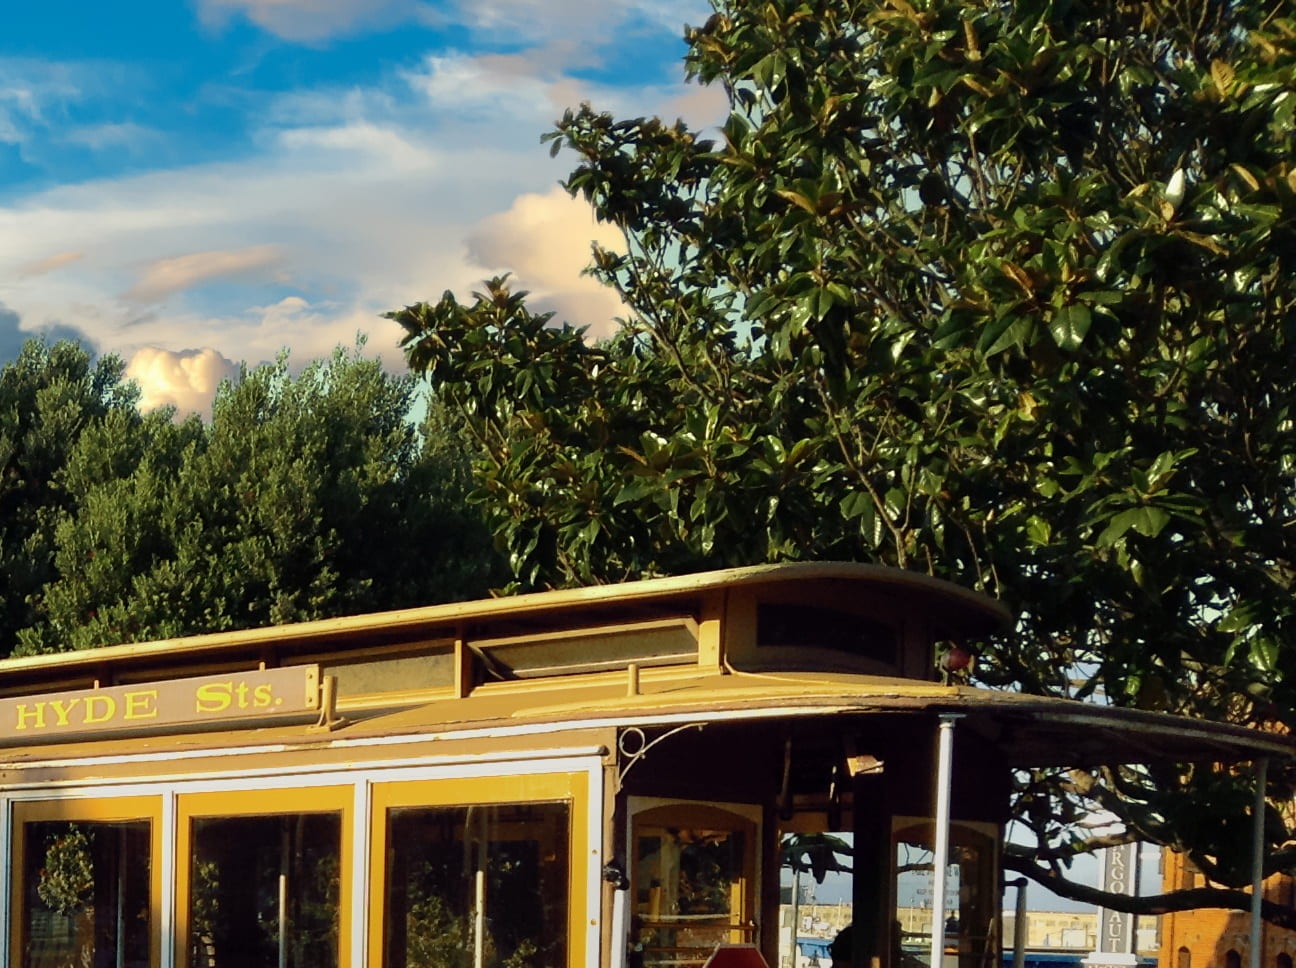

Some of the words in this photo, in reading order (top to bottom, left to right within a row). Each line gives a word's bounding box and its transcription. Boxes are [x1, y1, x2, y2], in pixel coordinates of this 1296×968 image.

[15, 689, 158, 731] HYDE
[195, 681, 284, 714] Sts.
[1108, 842, 1126, 953] RGOAUT
